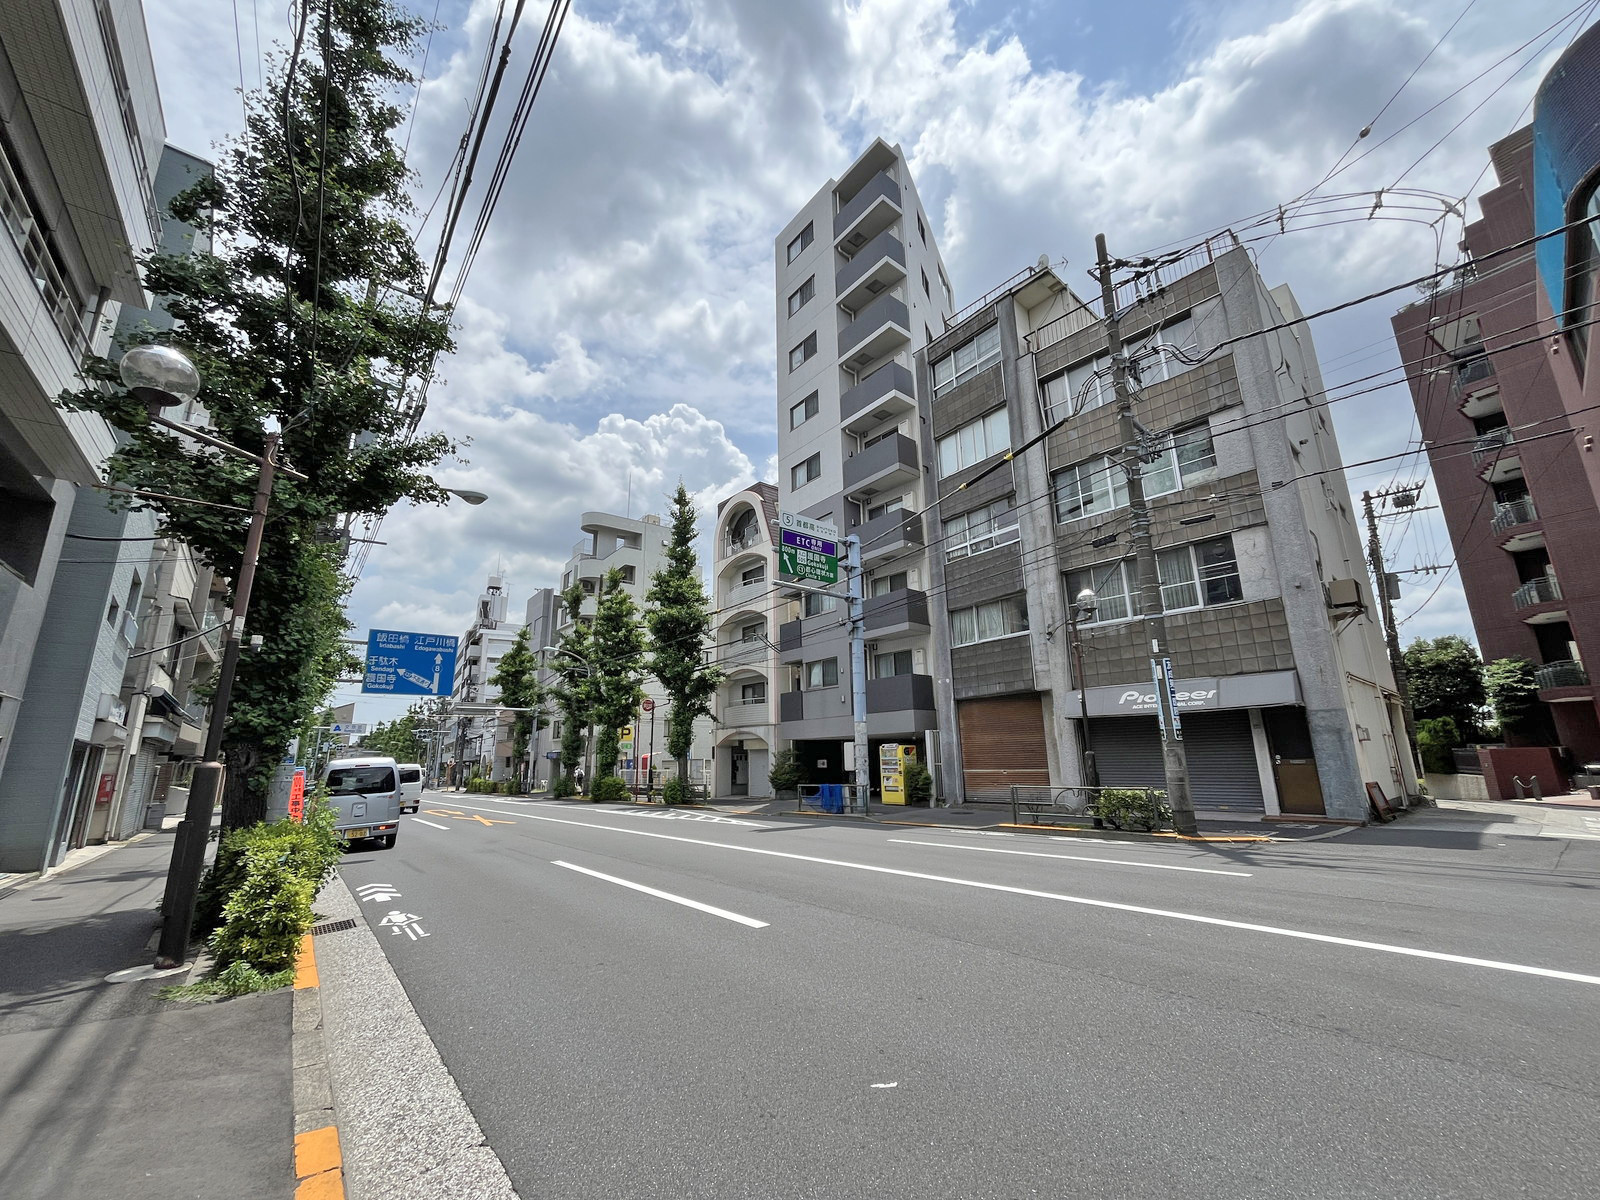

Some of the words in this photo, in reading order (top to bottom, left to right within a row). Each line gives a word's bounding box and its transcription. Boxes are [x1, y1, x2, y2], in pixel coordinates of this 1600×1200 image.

[786, 516, 791, 524] 5
[796, 536, 810, 547] ETC
[376, 632, 410, 644] 飯田橋
[414, 636, 456, 647] 江戸川橋
[371, 665, 394, 673] Sendagi
[1118, 690, 1217, 704] Pioeer
[621, 727, 631, 739] P
